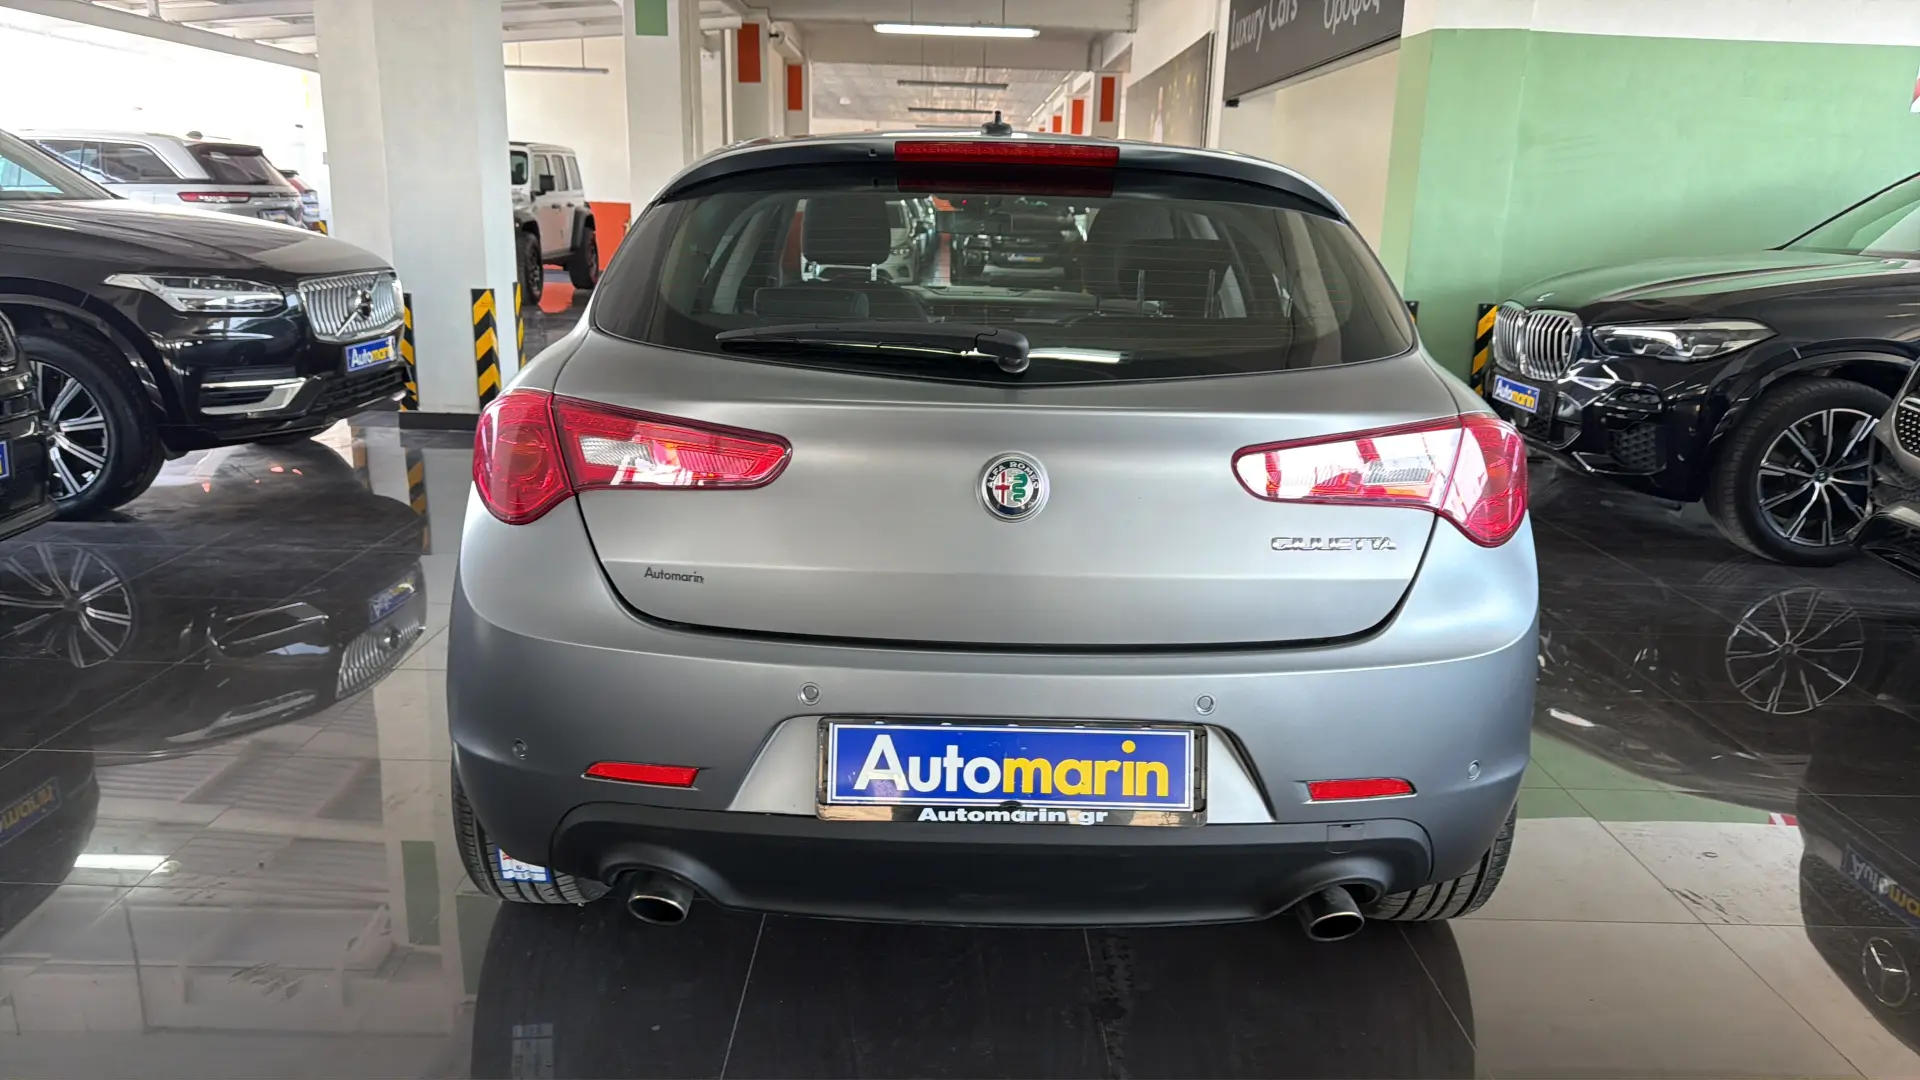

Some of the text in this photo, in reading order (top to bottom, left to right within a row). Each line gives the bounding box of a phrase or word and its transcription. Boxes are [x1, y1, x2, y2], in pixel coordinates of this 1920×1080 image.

[1230, 0, 1298, 52] Luxury Cars
[987, 461, 1039, 489] ALFA ROMEO
[1271, 537, 1397, 550] GIULIETTA
[643, 566, 705, 584] Automarin
[853, 733, 1169, 797] Automarin
[917, 807, 1109, 826] Automarin.gr
